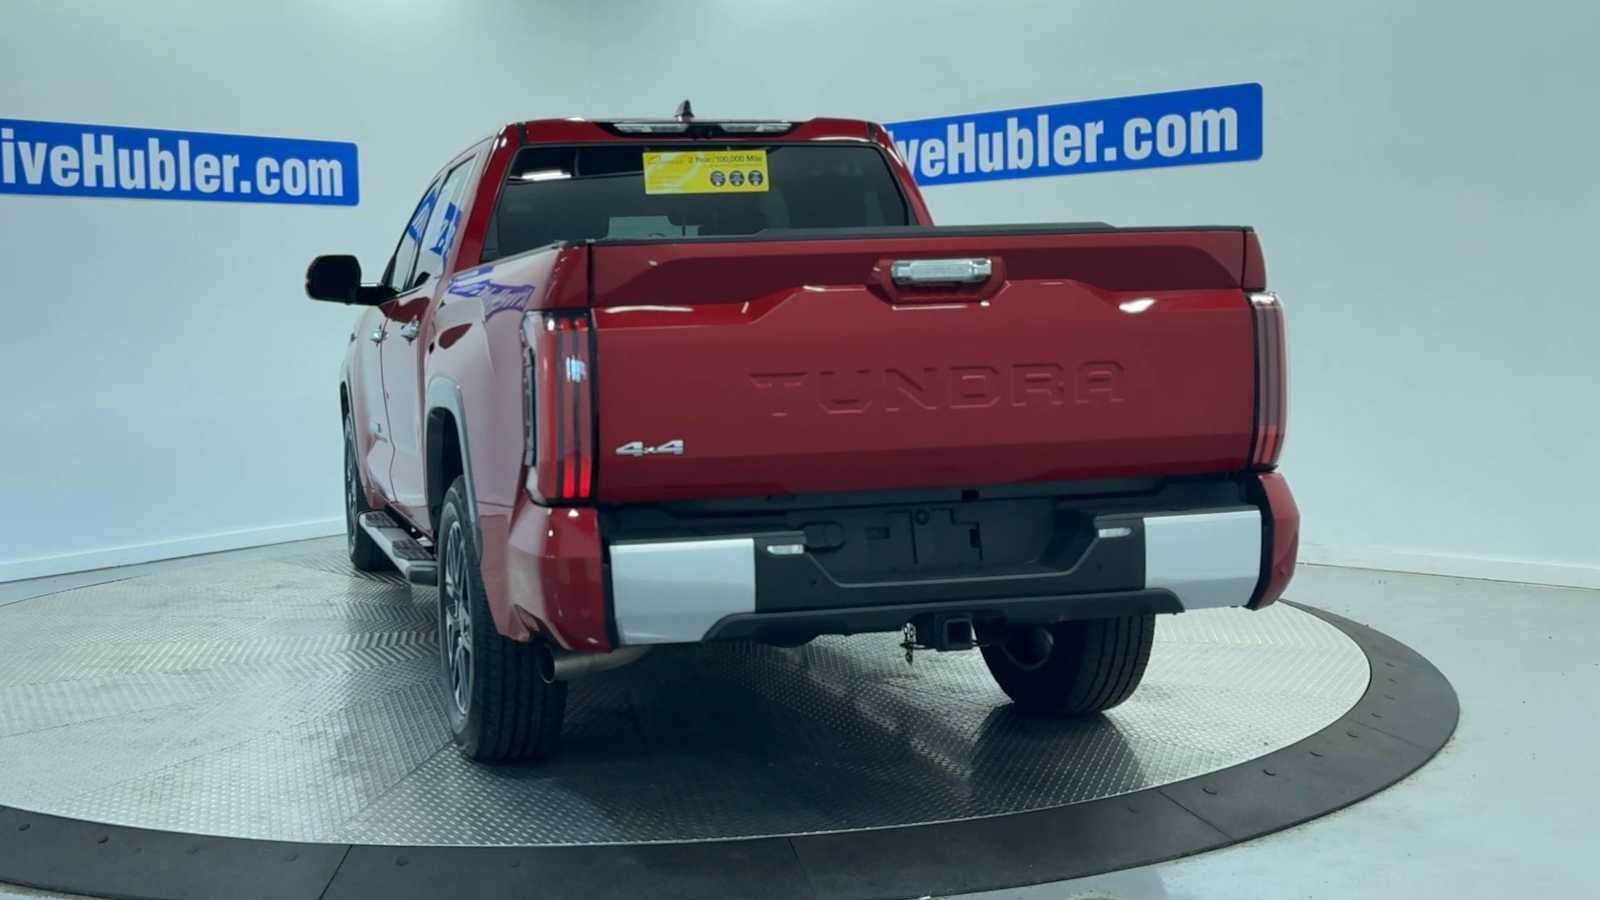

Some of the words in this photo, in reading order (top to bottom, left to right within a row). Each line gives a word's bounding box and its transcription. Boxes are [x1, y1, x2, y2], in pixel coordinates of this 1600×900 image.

[1, 128, 344, 197] iveHubler.com
[887, 106, 1238, 177] veHubler.com
[749, 360, 1125, 417] TUNDRA
